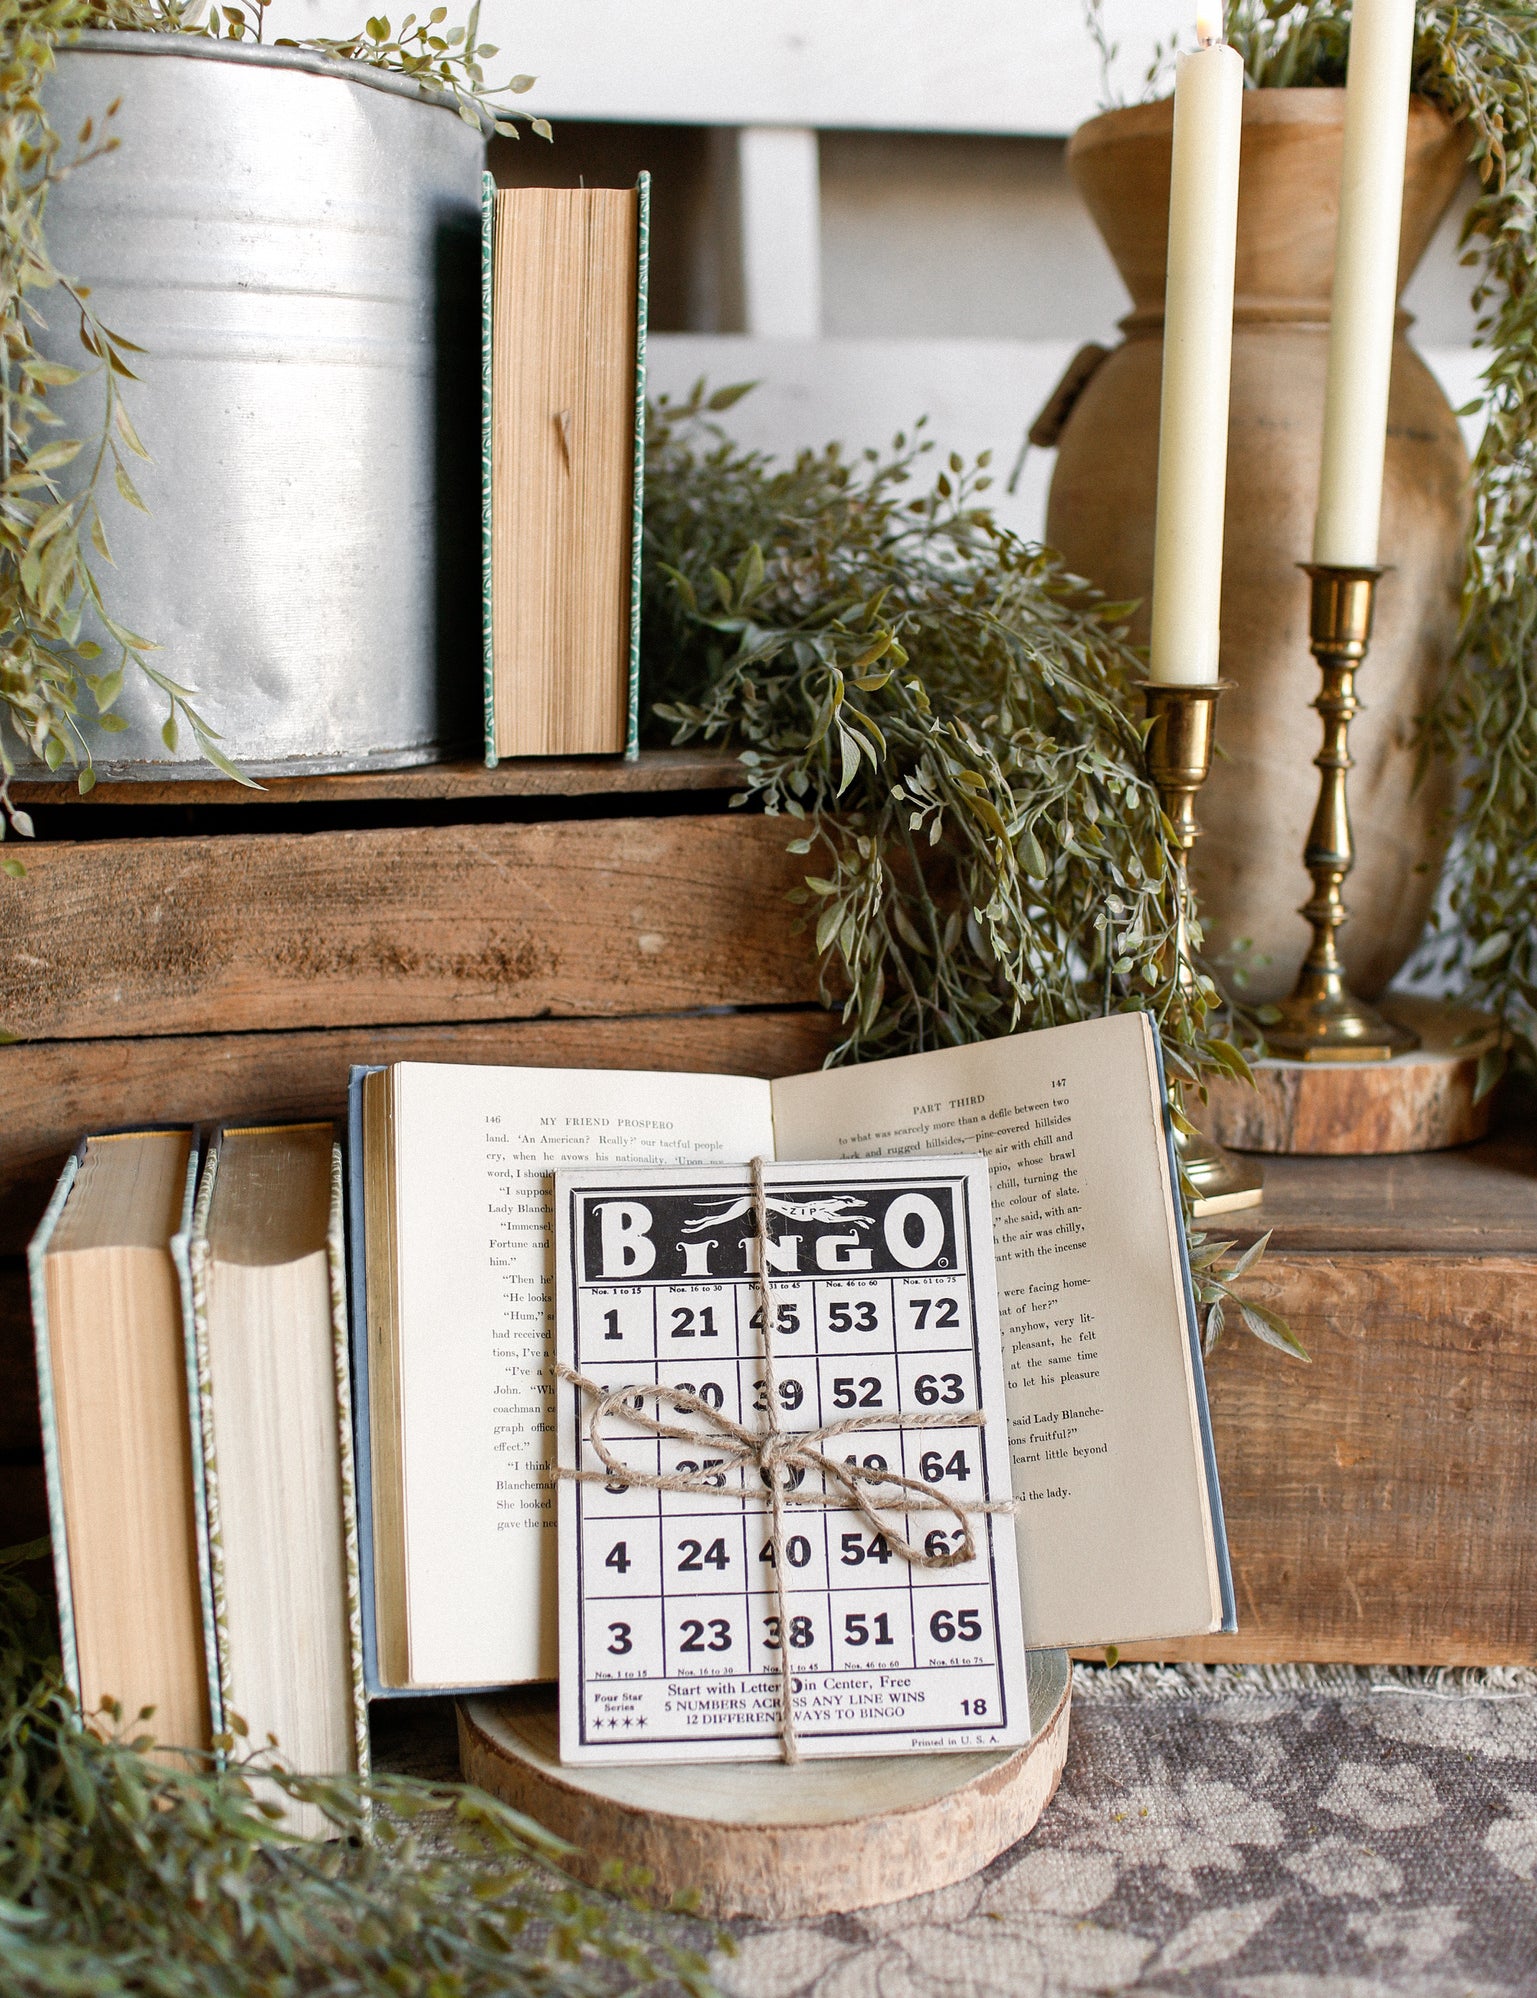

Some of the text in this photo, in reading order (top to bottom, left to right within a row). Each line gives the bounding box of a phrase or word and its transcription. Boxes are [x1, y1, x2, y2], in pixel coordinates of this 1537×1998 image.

[1051, 1078, 1066, 1088] 147
[913, 1094, 985, 1115] PART THIRD
[485, 1115, 674, 1130] 146 MY FRIEND PROSPERO
[838, 1098, 1069, 1146] to what was scarcely more than defile between two
[540, 1134, 590, 1144] American?
[659, 1139, 691, 1149] tactful
[694, 1141, 724, 1151] people
[865, 1114, 1071, 1158] and rugged hillsides
[995, 1131, 1074, 1154] air with chill and
[513, 1151, 537, 1161] when
[543, 1152, 555, 1161] he
[595, 1152, 609, 1161] his
[1017, 1150, 1076, 1168] whose brawl
[996, 1167, 1078, 1190] chill, turning the
[991, 1187, 1080, 1209] the colour of slate.
[488, 1204, 514, 1215] Lady
[1004, 1215, 1019, 1225] she
[1020, 1210, 1043, 1222] said,
[1044, 1206, 1065, 1218] with
[592, 1192, 946, 1278] BINGO
[1002, 1222, 1085, 1243] the air was chilly,
[489, 1239, 550, 1249] Fortune and
[1014, 1240, 1087, 1259] with the incense
[846, 1279, 878, 1287] 46 60
[1004, 1278, 1091, 1297] were facing home-
[528, 1292, 552, 1302] looks
[1015, 1304, 1026, 1314] of
[604, 1309, 623, 1340] 1
[670, 1306, 718, 1338] 21
[828, 1301, 879, 1333] 53
[909, 1298, 960, 1330] 72
[1009, 1322, 1049, 1335] anyhow,
[1054, 1317, 1075, 1328] very
[492, 1329, 551, 1339] had received
[1012, 1331, 1096, 1354] pleasant, he felt
[1010, 1350, 1098, 1371] at the same time
[1007, 1370, 1100, 1389] to let his pleasure
[833, 1376, 883, 1408] 52
[914, 1373, 965, 1405] 63
[492, 1404, 541, 1413] coachman
[1012, 1406, 1104, 1427] said Lady Blanche-
[493, 1423, 555, 1435] graph office
[1013, 1443, 1108, 1465] learnt little beyond
[920, 1450, 971, 1483] 64
[1029, 1487, 1072, 1500] the lady.
[496, 1500, 552, 1510] She looked
[497, 1518, 539, 1531] gave the
[605, 1541, 631, 1574] 4
[677, 1538, 731, 1572] 24
[758, 1535, 812, 1569] 40
[840, 1532, 893, 1566] 54
[607, 1609, 982, 1655] 3 23 38 51 65
[667, 1675, 911, 1697] Start with Letter in Center, Free
[594, 1693, 643, 1702] Four Star
[664, 1691, 926, 1712] 5 NUMBERS ACRSS ANY LINE WINS
[960, 1698, 987, 1716] 18
[604, 1703, 635, 1712] Series
[686, 1714, 698, 1725] 12
[702, 1712, 783, 1725] DIFFERENT
[835, 1709, 856, 1720] TO
[860, 1707, 905, 1719] BINGO
[911, 1737, 944, 1748] Printed
[947, 1737, 957, 1746] in
